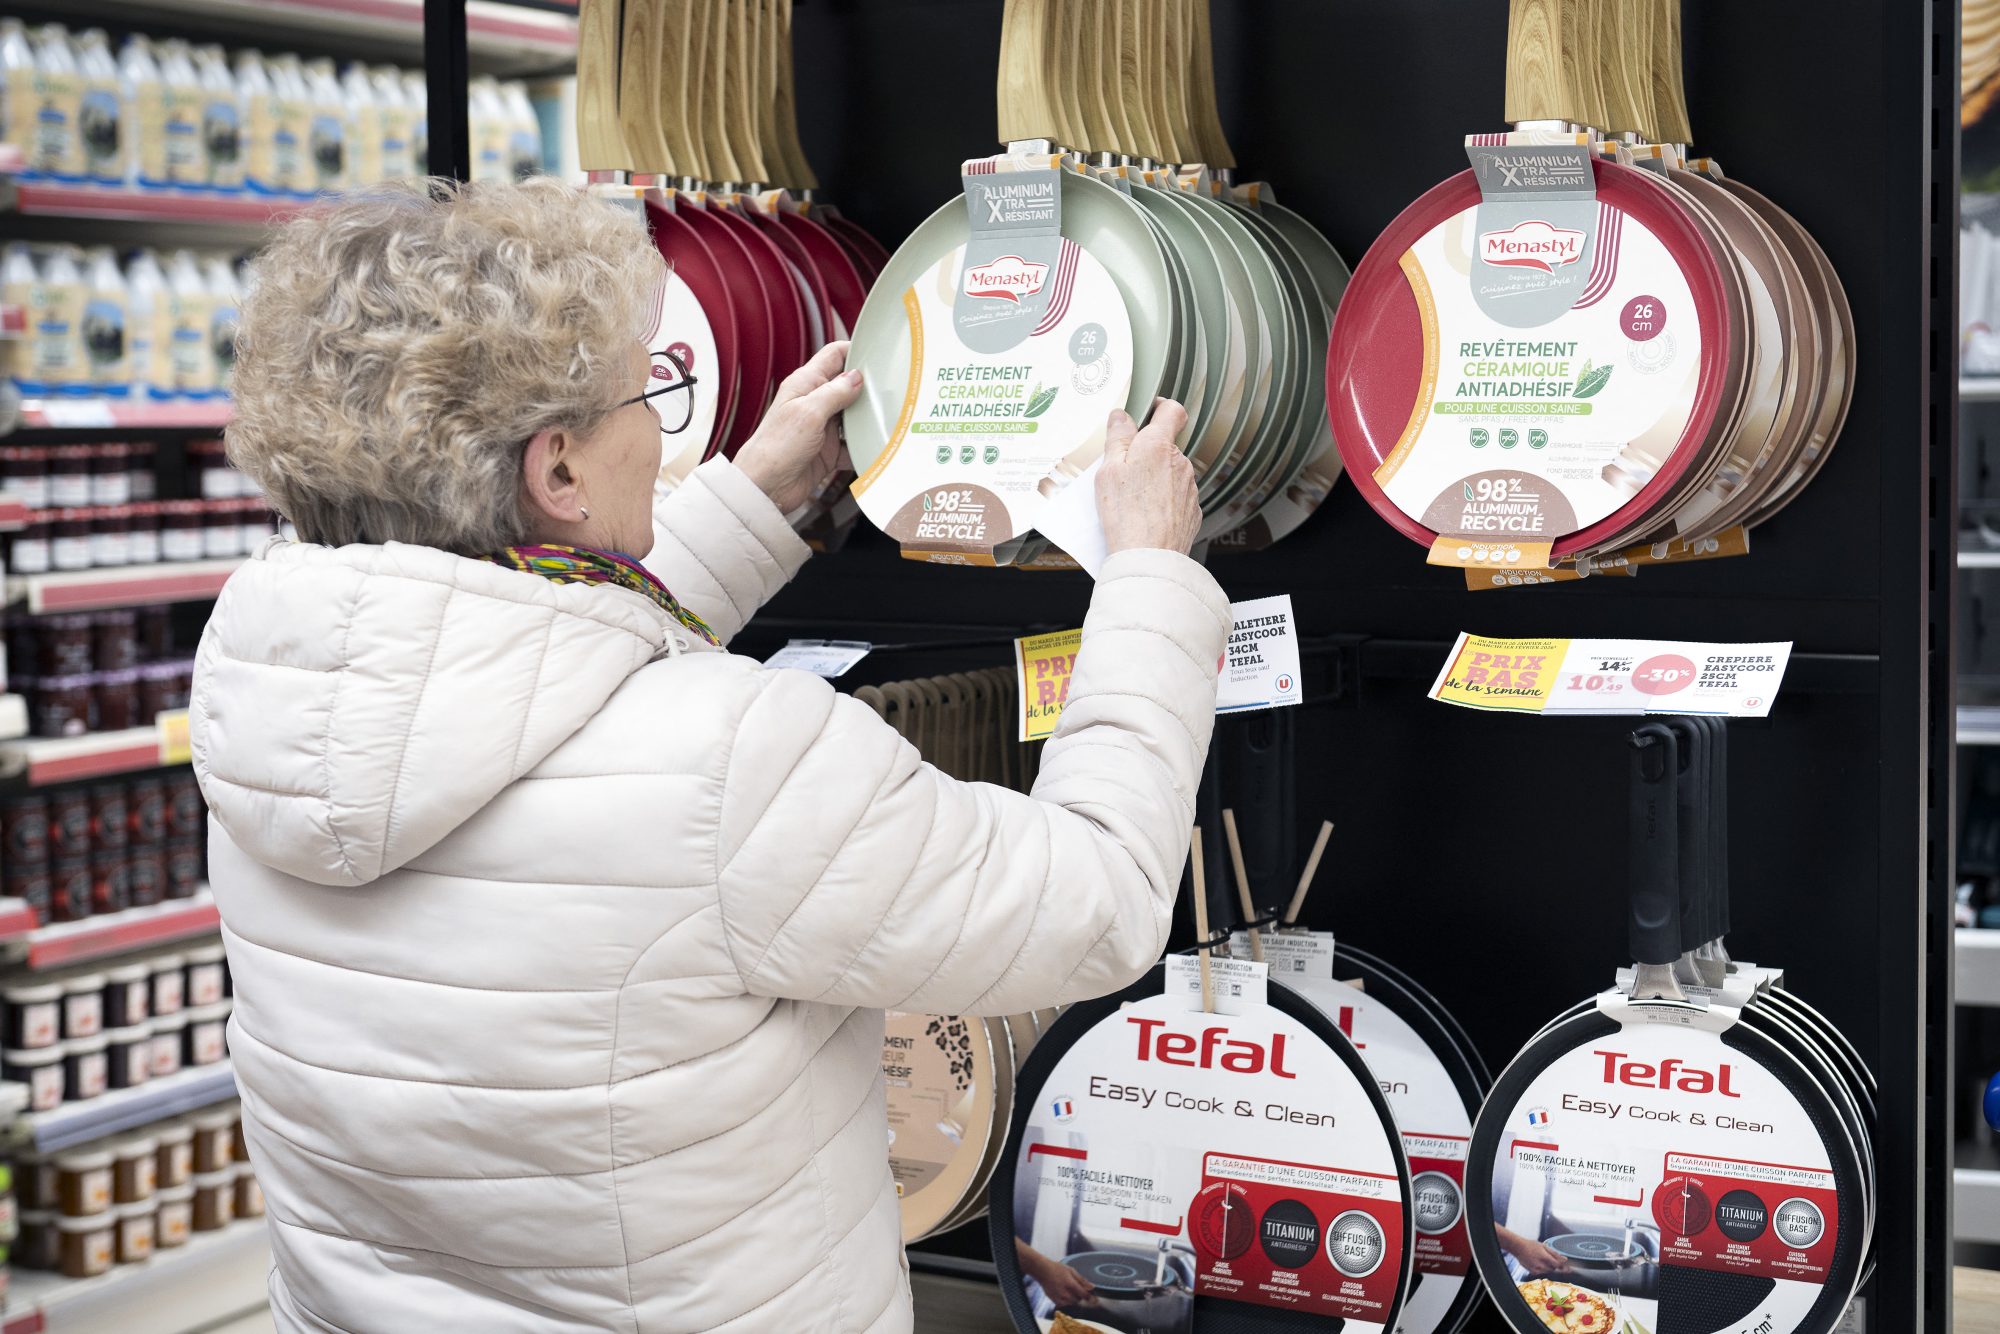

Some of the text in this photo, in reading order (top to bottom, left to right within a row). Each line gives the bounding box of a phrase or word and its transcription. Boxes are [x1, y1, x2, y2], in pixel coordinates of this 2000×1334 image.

[1494, 156, 1582, 168] ALUMINIUM
[1523, 176, 1584, 186] RÉSISTANT
[984, 183, 1053, 200] ALUMINIUM
[1005, 210, 1054, 222] RÉSISTANT
[1488, 238, 1576, 256] Menastyl
[970, 270, 1040, 288] Menastyl
[1634, 304, 1653, 318] 26
[1632, 322, 1652, 331] cm
[1080, 331, 1096, 344] 26
[1078, 347, 1095, 356] cm
[1459, 339, 1578, 357] REVÊTEMENT
[937, 364, 1032, 380] REVÊTEMENT
[1464, 358, 1570, 377] CÉRAMIQUE
[938, 382, 1024, 399] CÉRAMIQUE
[1456, 378, 1573, 397] ANTIADHÉSIF
[930, 400, 1025, 417] ANTIADHÉSIF
[1444, 404, 1581, 414] POUR UNE CUISSON SAINE
[919, 424, 1029, 432] POUR UNE CUISSON SAINE
[1476, 478, 1522, 502] 98%
[933, 490, 972, 512] 98%
[1462, 503, 1538, 514] ALUMINIUM
[920, 512, 982, 524] ALUMINIUM
[1460, 513, 1544, 531] RECYCLÉ
[916, 521, 986, 540] RECYCLÉ
[1234, 614, 1286, 630] ALETIERE
[1228, 626, 1286, 644] EASYCOOK
[1229, 643, 1258, 655] 34CM
[1035, 653, 1077, 679] PRI
[1230, 655, 1264, 668] TEFAL
[1470, 652, 1546, 670] PRIX
[1280, 679, 1288, 689] U
[1461, 666, 1540, 689] BAS
[1036, 677, 1071, 705] BA
[1445, 678, 1544, 696] de la semaine
[1027, 705, 1040, 718] de
[1043, 700, 1055, 716] la
[1127, 1017, 1296, 1079] Tefal
[1594, 1050, 1740, 1098] Tefal
[1089, 1076, 1157, 1109] Easy
[1165, 1092, 1225, 1114] Cook
[1234, 1100, 1255, 1117] &
[1265, 1104, 1336, 1128] Clean
[1562, 1094, 1774, 1134] Easy Cook & Clean
[1415, 1139, 1459, 1150] PARFAITE
[1518, 1152, 1636, 1174] 100% FACILE À NETTOYER
[1682, 1158, 1722, 1168] GARANTIE
[1724, 1162, 1748, 1171] D'UNE
[1751, 1166, 1786, 1176] CUISSON
[1789, 1170, 1827, 1181] PARFAITE
[1058, 1166, 1079, 1179] 100%
[1080, 1169, 1105, 1183] FACILE
[1115, 1175, 1154, 1191] NETTOYER
[1209, 1158, 1384, 1189] LA GARANTIE D'UNE CUISSON PARFAITE
[1267, 1175, 1291, 1184] perfect
[1610, 1174, 1634, 1183] MAKEN
[1145, 1192, 1172, 1205] MAKEN
[1420, 1204, 1444, 1215] BASE
[1720, 1206, 1763, 1222] TITANIUM
[1780, 1214, 1818, 1225] DIFFUSION
[1266, 1222, 1315, 1242] TITANIUM
[1789, 1224, 1808, 1233] BASE
[1334, 1231, 1378, 1247] DIFFUSION
[1344, 1245, 1366, 1258] BASE
